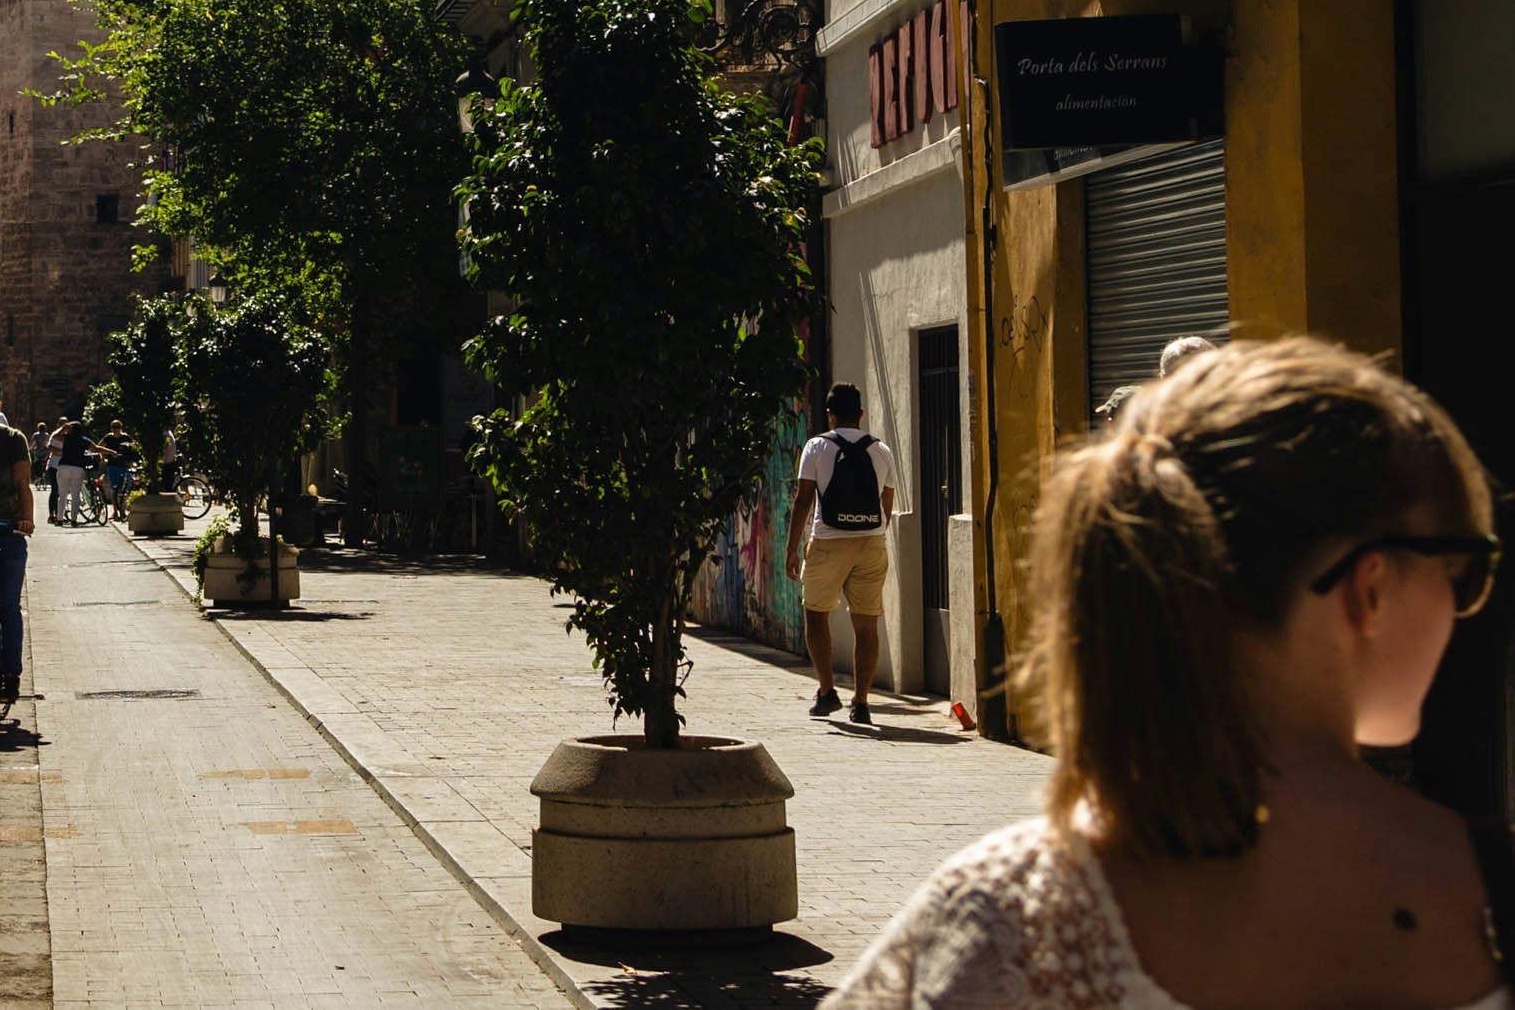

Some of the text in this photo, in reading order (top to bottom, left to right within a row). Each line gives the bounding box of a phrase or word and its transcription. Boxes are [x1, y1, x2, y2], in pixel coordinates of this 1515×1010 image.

[1017, 50, 1168, 76] Porta dels Serrans
